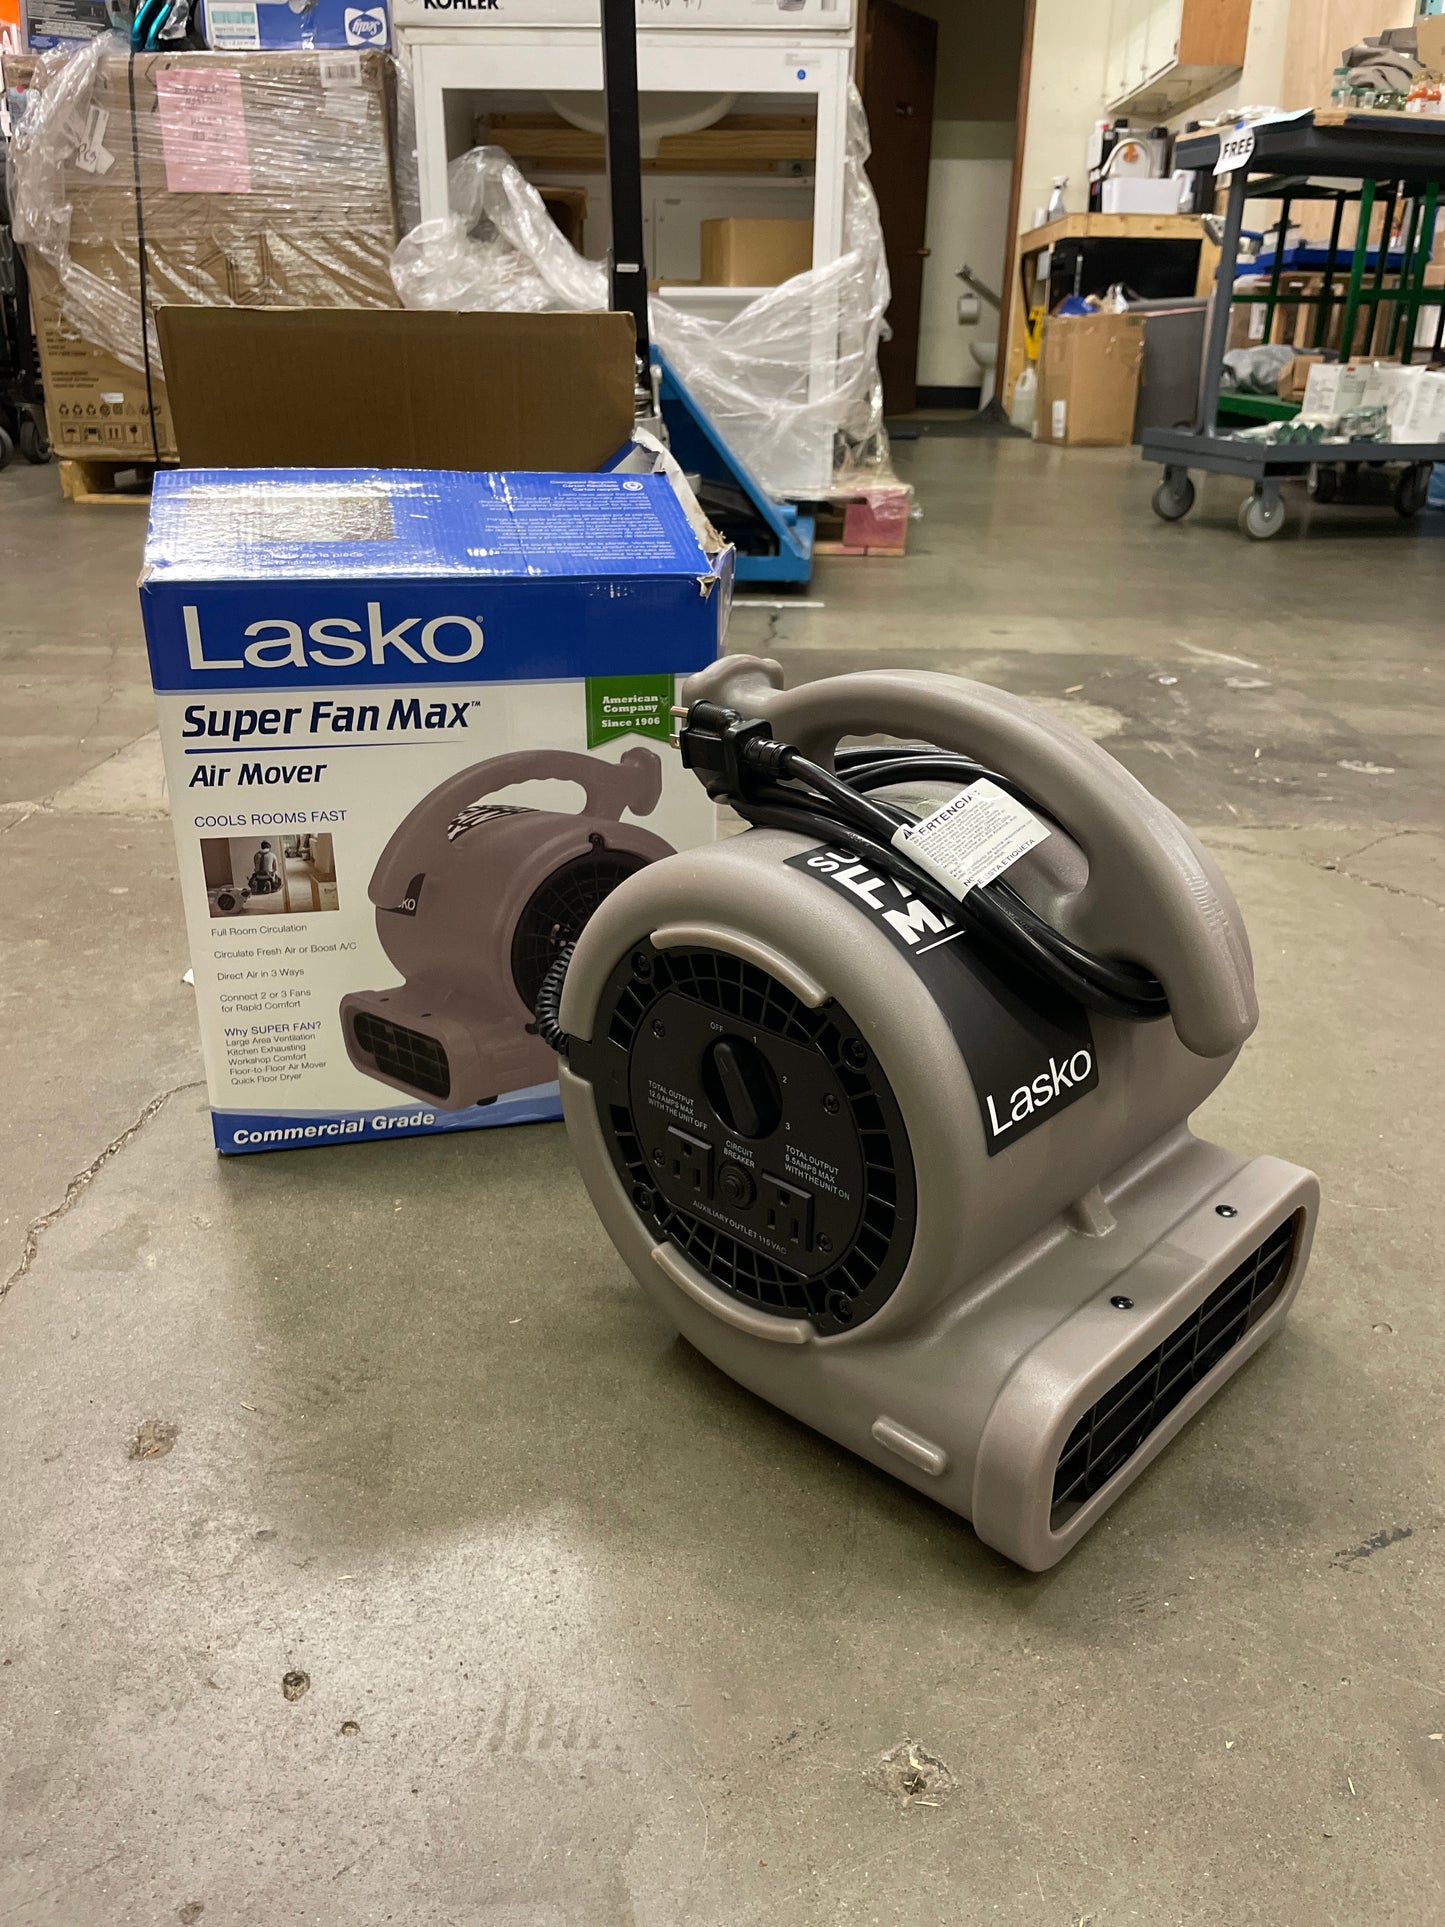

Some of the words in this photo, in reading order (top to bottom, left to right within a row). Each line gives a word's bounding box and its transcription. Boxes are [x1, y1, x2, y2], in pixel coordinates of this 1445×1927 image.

[1222, 137, 1253, 159] FREE
[602, 694, 659, 704] American
[603, 704, 658, 714] Company
[182, 704, 302, 742] Super
[309, 701, 379, 733] Fan
[601, 719, 632, 728] Since
[635, 717, 660, 726] 1906
[188, 764, 231, 788] Air
[237, 762, 328, 786] Mover
[194, 814, 247, 828] COOLS
[251, 811, 307, 825] ROOMS
[311, 809, 348, 823] FAST
[1001, 838, 1036, 866] ETIQUETA
[211, 928, 227, 937] Full
[229, 927, 257, 936] Room
[259, 923, 308, 934] Circulation
[213, 950, 254, 960] Circulate
[256, 947, 282, 957] Fresh
[284, 945, 296, 955] Air
[298, 946, 308, 954] or
[310, 943, 337, 953] Boost
[339, 941, 357, 951] A/C
[217, 971, 243, 981] Direct
[246, 970, 258, 979] Air
[260, 969, 269, 978] in
[271, 969, 277, 977] 3
[279, 968, 305, 978] Ways
[219, 993, 258, 1003] Connect
[261, 992, 267, 1000] 2
[269, 991, 278, 999] or
[281, 990, 287, 998] 3
[289, 988, 312, 998] Fans
[221, 1004, 233, 1013] for
[236, 1002, 263, 1014] Rapid
[264, 1000, 301, 1010] Comfort
[224, 1026, 248, 1038] Why
[251, 1023, 290, 1035] SUPER
[293, 1020, 322, 1032] FAN?
[709, 1021, 724, 1033] OFF
[225, 1038, 250, 1048] Large
[252, 1036, 271, 1045] Area
[273, 1033, 316, 1043] Ventilation
[752, 1036, 758, 1045] 1
[227, 1047, 259, 1056] Kitchen
[260, 1043, 306, 1055] Exhausting
[228, 1056, 271, 1067] Workshop
[273, 1053, 307, 1063] Comfort
[288, 1062, 299, 1071] Air
[301, 1060, 327, 1070] Mover
[230, 1077, 255, 1087] Quick
[257, 1074, 278, 1083] Floor
[280, 1072, 302, 1082] Dryer
[782, 1075, 788, 1085] 2
[648, 1079, 668, 1095] TOTAL
[668, 1089, 694, 1106] OUTPUT
[986, 1049, 1093, 1137] Lasko
[647, 1096, 665, 1111] WITH
[665, 1104, 678, 1117] THE
[678, 1111, 694, 1124] UNIT
[694, 1119, 708, 1131] OFF
[661, 1095, 680, 1109] AMPS
[680, 1103, 694, 1116] MAX
[233, 1117, 365, 1145] Commercial
[371, 1111, 437, 1130] Grade
[785, 1122, 791, 1131] 3
[725, 1139, 754, 1158] CIRCUIT
[723, 1147, 755, 1169] BREAKER
[785, 1144, 808, 1162] TOTAL
[808, 1155, 840, 1176] OUTPUT
[784, 1162, 804, 1179] WITH
[804, 1171, 820, 1186] THE
[819, 1179, 838, 1195] UNIT
[838, 1189, 850, 1201] ON
[818, 1169, 836, 1184] MAX
[692, 1199, 729, 1223] AUXILIARY
[729, 1219, 758, 1240] OUTLET
